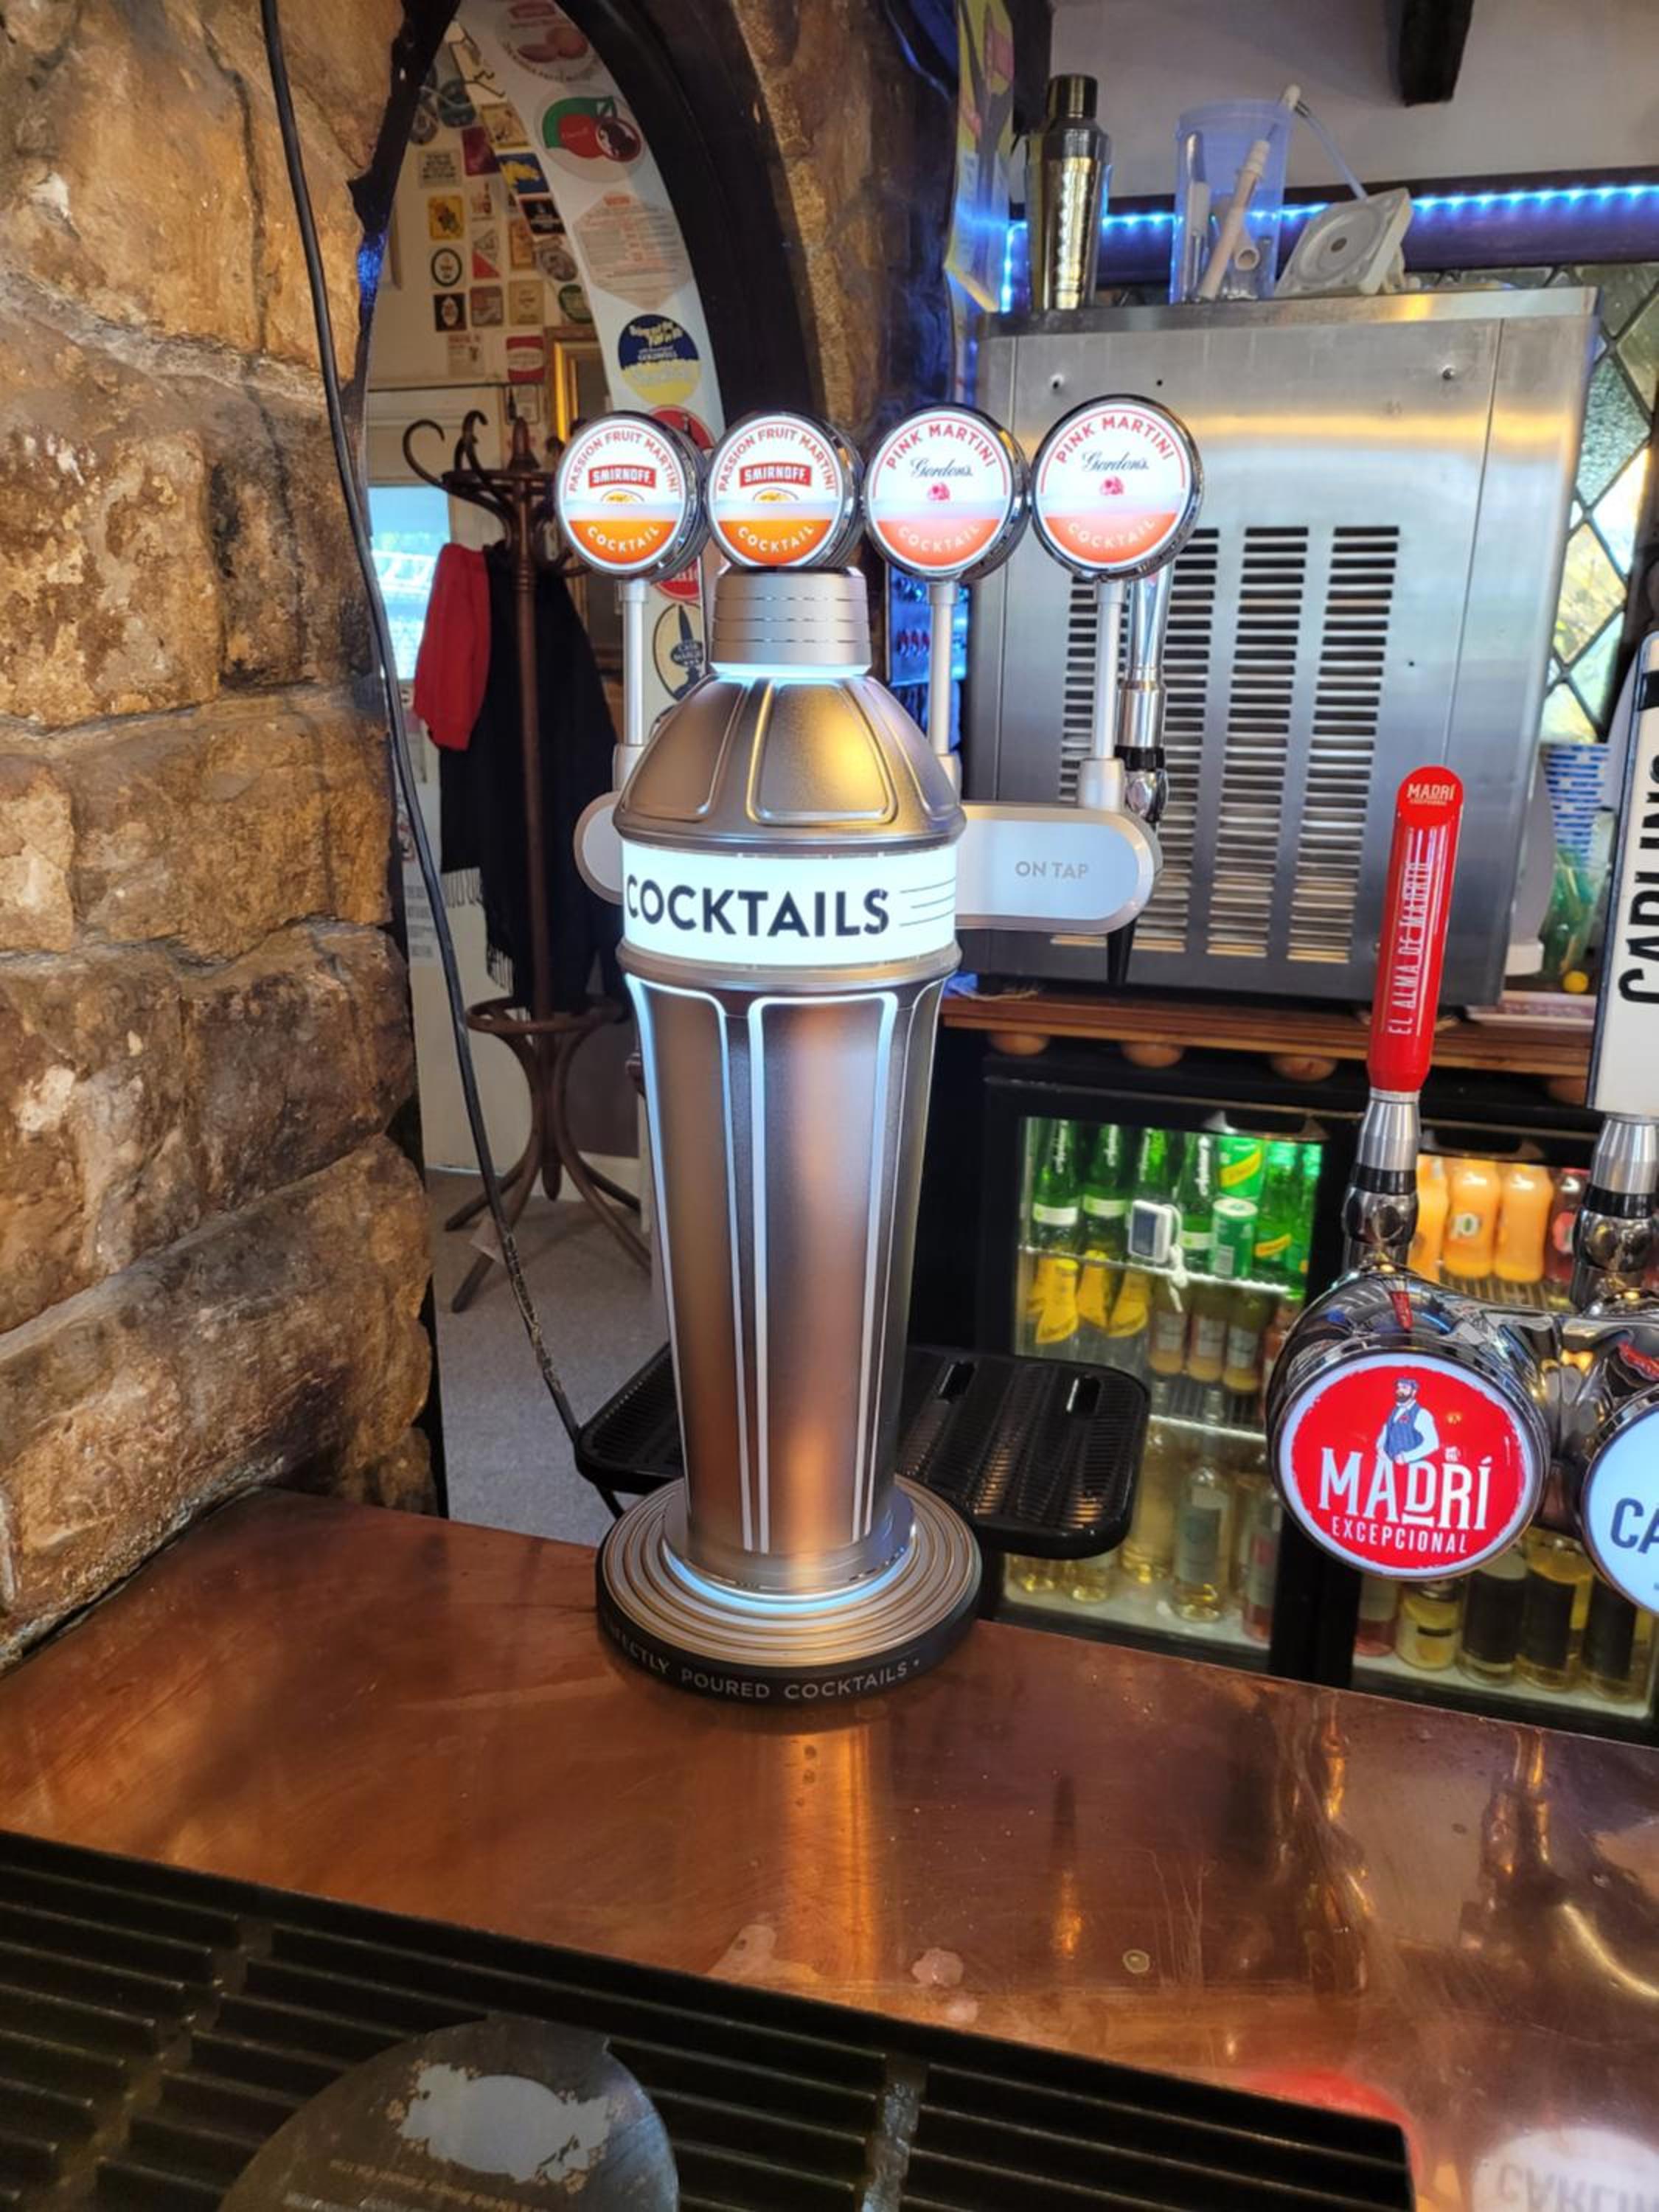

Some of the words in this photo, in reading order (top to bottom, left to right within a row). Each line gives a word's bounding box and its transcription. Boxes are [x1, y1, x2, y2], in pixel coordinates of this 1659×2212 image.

[886, 429, 922, 470] PINK
[928, 424, 996, 467] MARTINI
[1056, 422, 1095, 465] PINK
[1102, 415, 1175, 460] MARTINI
[569, 437, 603, 493] PASSION
[605, 429, 642, 443] FRUIT
[644, 438, 679, 493] MARTINI
[718, 436, 756, 492] PASSION
[757, 427, 797, 442] FRUIT
[799, 436, 835, 490] MARTINI
[587, 526, 659, 552] COCKTAIL
[738, 526, 815, 552] COCKTAIL
[897, 524, 981, 552] COCKTAIL
[1068, 518, 1155, 547] COCKTAIL
[1015, 860, 1047, 877] ON
[1051, 860, 1089, 880] TAP
[627, 874, 889, 938] COCKTAILS
[1391, 964, 1420, 1010] ALMA
[1388, 1016, 1413, 1035] EL
[1318, 1446, 1493, 1531] MADRÍ
[1332, 1516, 1467, 1554] EXCEPCIONAL
[681, 1668, 771, 1698] POURED
[784, 1661, 908, 1699] COCKTAILS
